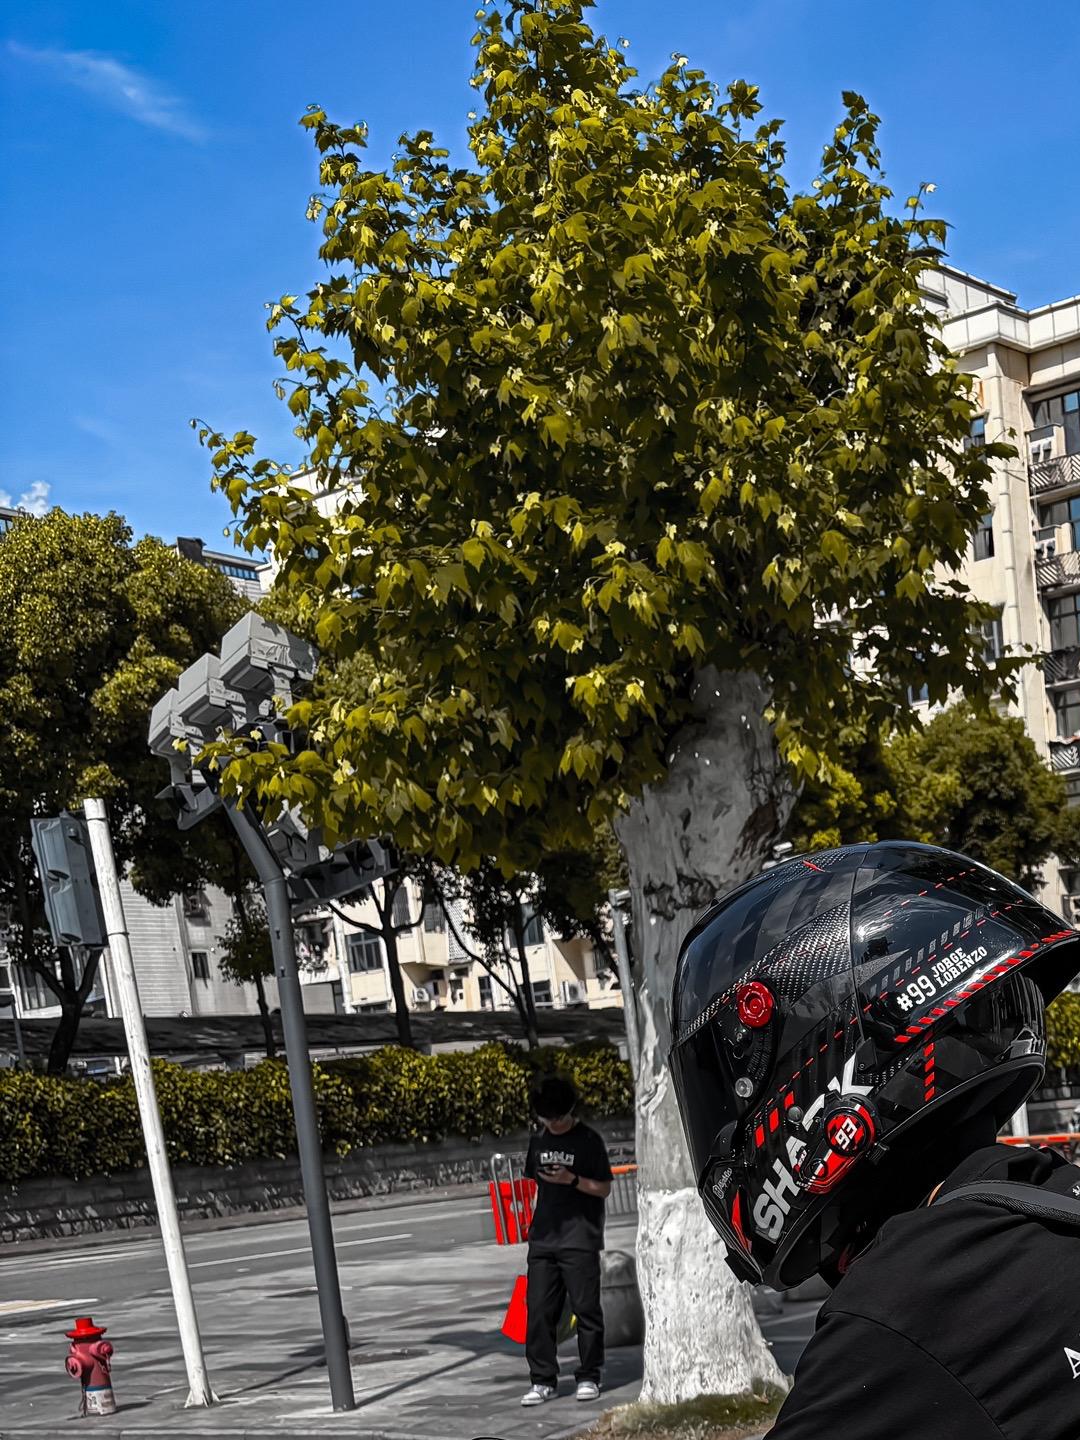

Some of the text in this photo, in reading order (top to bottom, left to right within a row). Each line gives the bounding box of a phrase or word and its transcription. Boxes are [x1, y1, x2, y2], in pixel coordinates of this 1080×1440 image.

[931, 947, 966, 977] JORGE
[936, 946, 988, 987] LORENZO
[896, 975, 937, 1011] #99
[834, 1117, 858, 1150] 93
